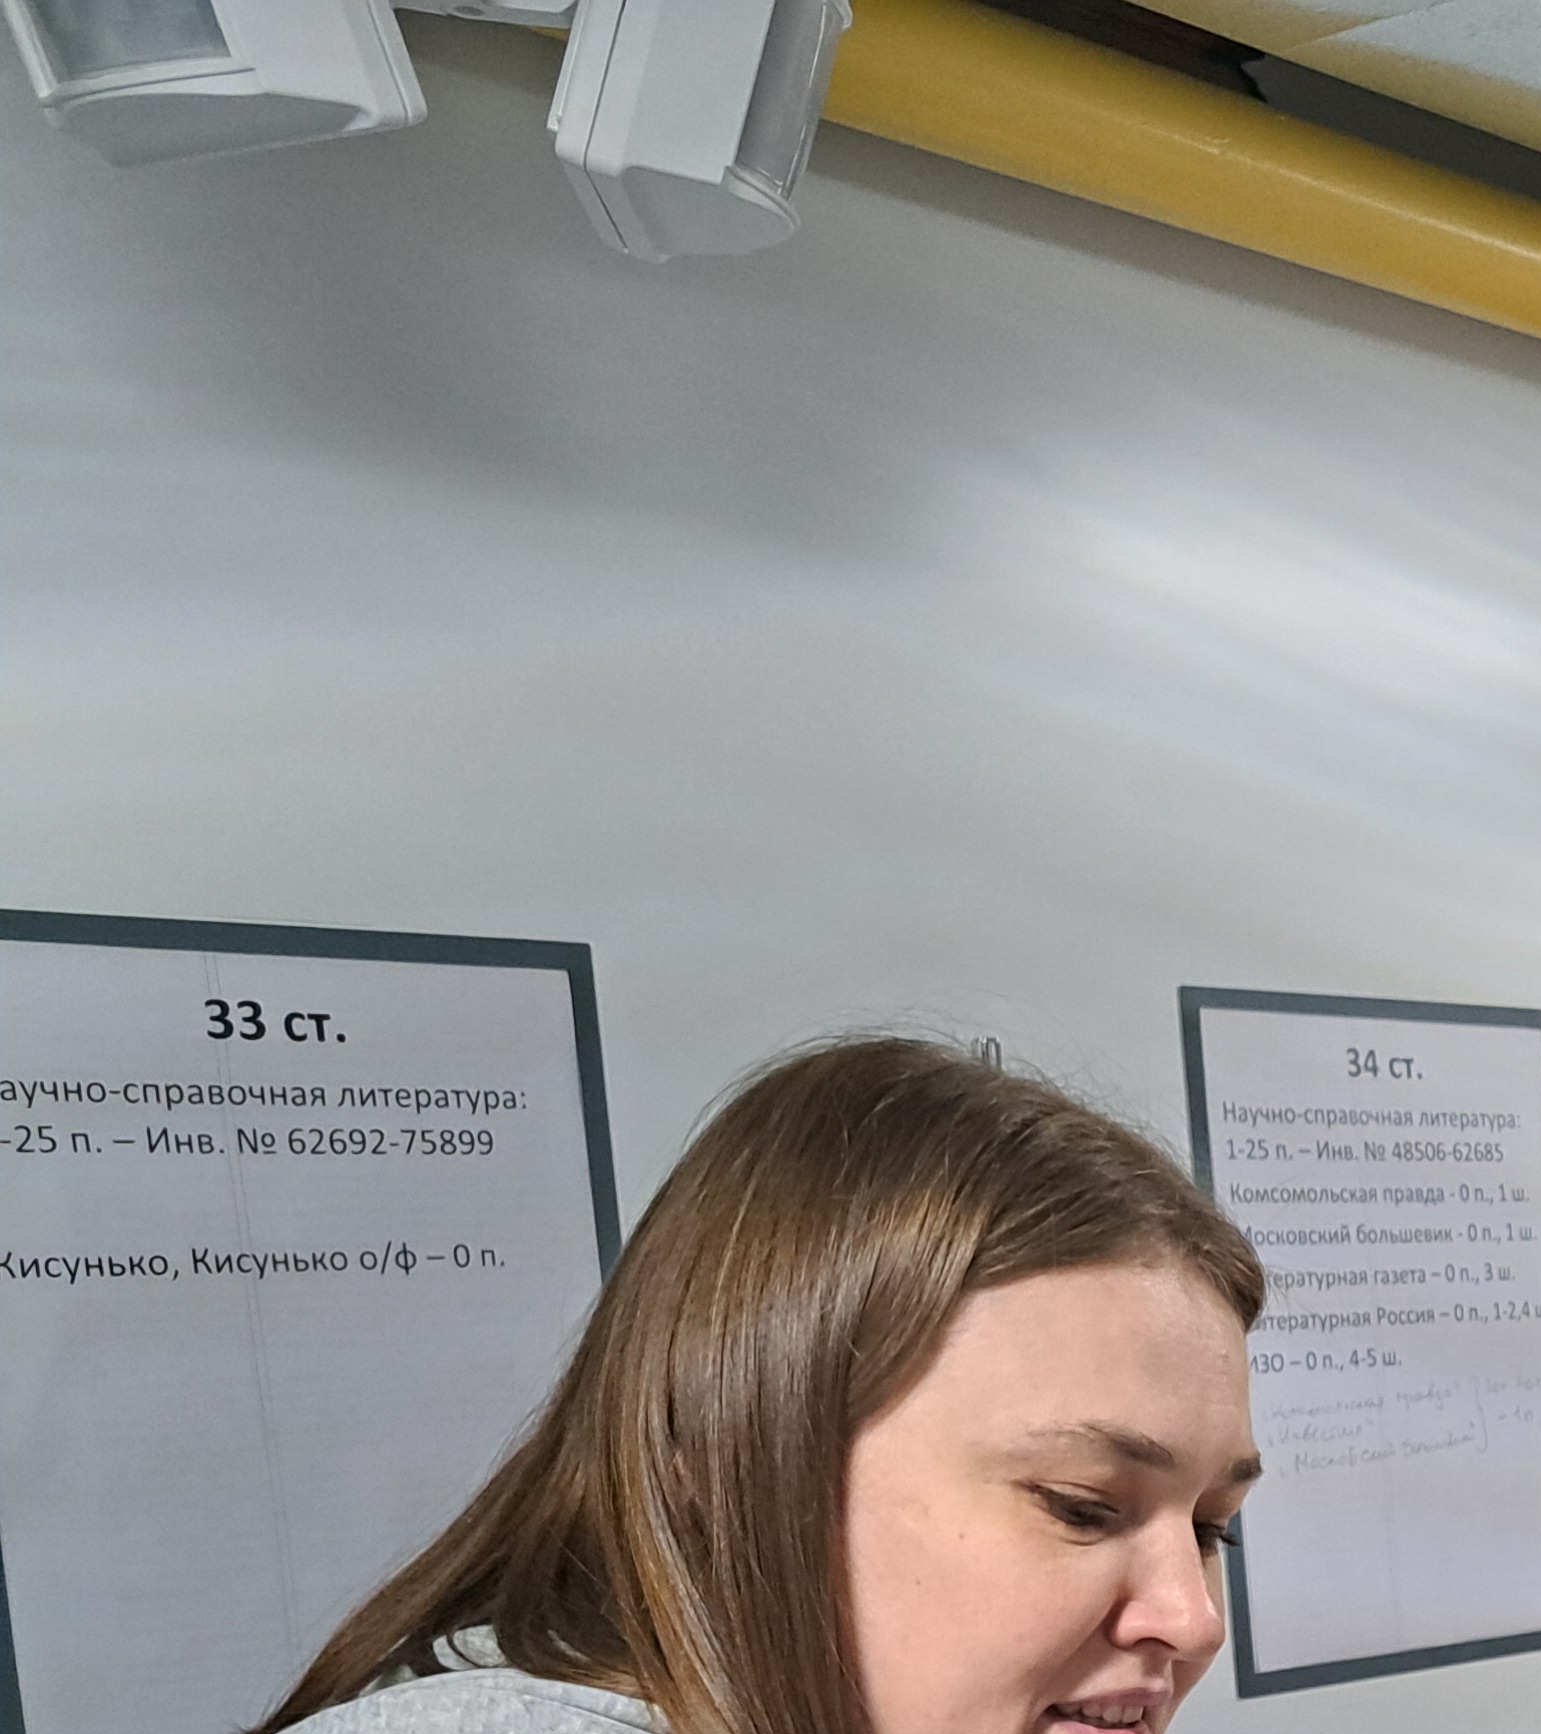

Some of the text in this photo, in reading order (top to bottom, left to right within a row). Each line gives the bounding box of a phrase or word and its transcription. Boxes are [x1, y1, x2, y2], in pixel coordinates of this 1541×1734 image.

[204, 998, 347, 1043] 33 ст.
[1346, 1047, 1423, 1080] 34 ст.
[0, 1078, 527, 1116] аучно-справочная литература:
[1222, 1101, 1522, 1133] Научно-справочная литература:
[0, 1125, 58, 1154] -25
[71, 1132, 103, 1154] п.
[146, 1127, 226, 1155] Инв.
[237, 1128, 278, 1156] №
[287, 1127, 495, 1156] 62692-75899
[1226, 1139, 1270, 1161] 1-25
[1275, 1145, 1294, 1162] п.
[1316, 1141, 1359, 1162] Инв.
[1364, 1142, 1387, 1162] №
[1391, 1142, 1505, 1163] 48506-62685
[1230, 1183, 1377, 1205] Комсомольская
[1383, 1188, 1446, 1209] правда
[1498, 1184, 1508, 1202] 1
[1511, 1187, 1531, 1203] ш.
[1356, 1224, 1453, 1245] большевик
[1505, 1223, 1515, 1241] 1
[1519, 1227, 1538, 1242] ш.
[191, 1245, 349, 1284] Кисунько
[359, 1239, 418, 1276] о/ф
[452, 1243, 472, 1270] 0
[480, 1247, 507, 1268] п.
[1374, 1268, 1427, 1284] газета
[1484, 1263, 1493, 1281] 3
[1498, 1265, 1517, 1281] ш.
[1376, 1306, 1436, 1325] Россия
[1349, 1348, 1379, 1368] 4-5
[1382, 1349, 1402, 1367] ш.
